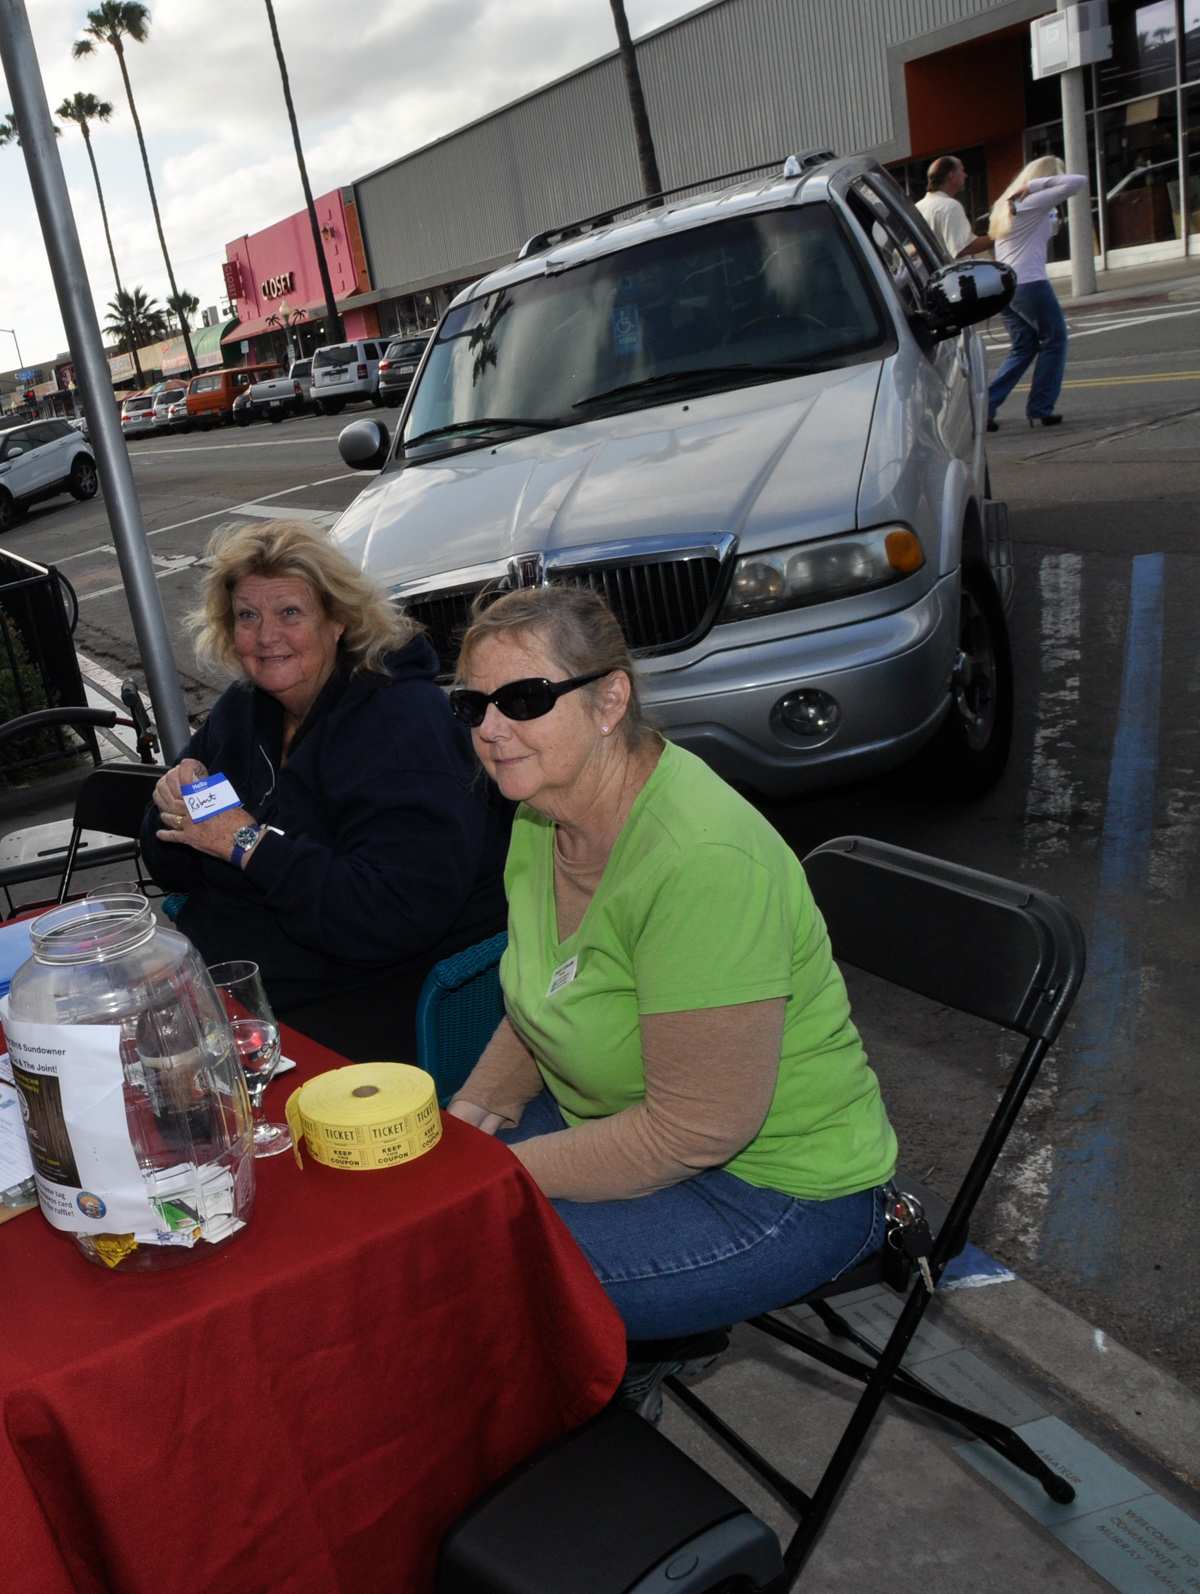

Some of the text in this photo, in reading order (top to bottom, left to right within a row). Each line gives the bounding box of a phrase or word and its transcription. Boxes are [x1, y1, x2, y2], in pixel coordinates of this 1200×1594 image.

[261, 272, 293, 300] CLOSET
[22, 1044, 67, 1056] Sundowner
[36, 1063, 58, 1073] Joint!
[325, 1128, 354, 1141] TICKET
[372, 1122, 404, 1138] TICKET
[382, 1144, 402, 1153] KEEP
[330, 1157, 360, 1167] COUPON
[377, 1152, 409, 1164] COUPON
